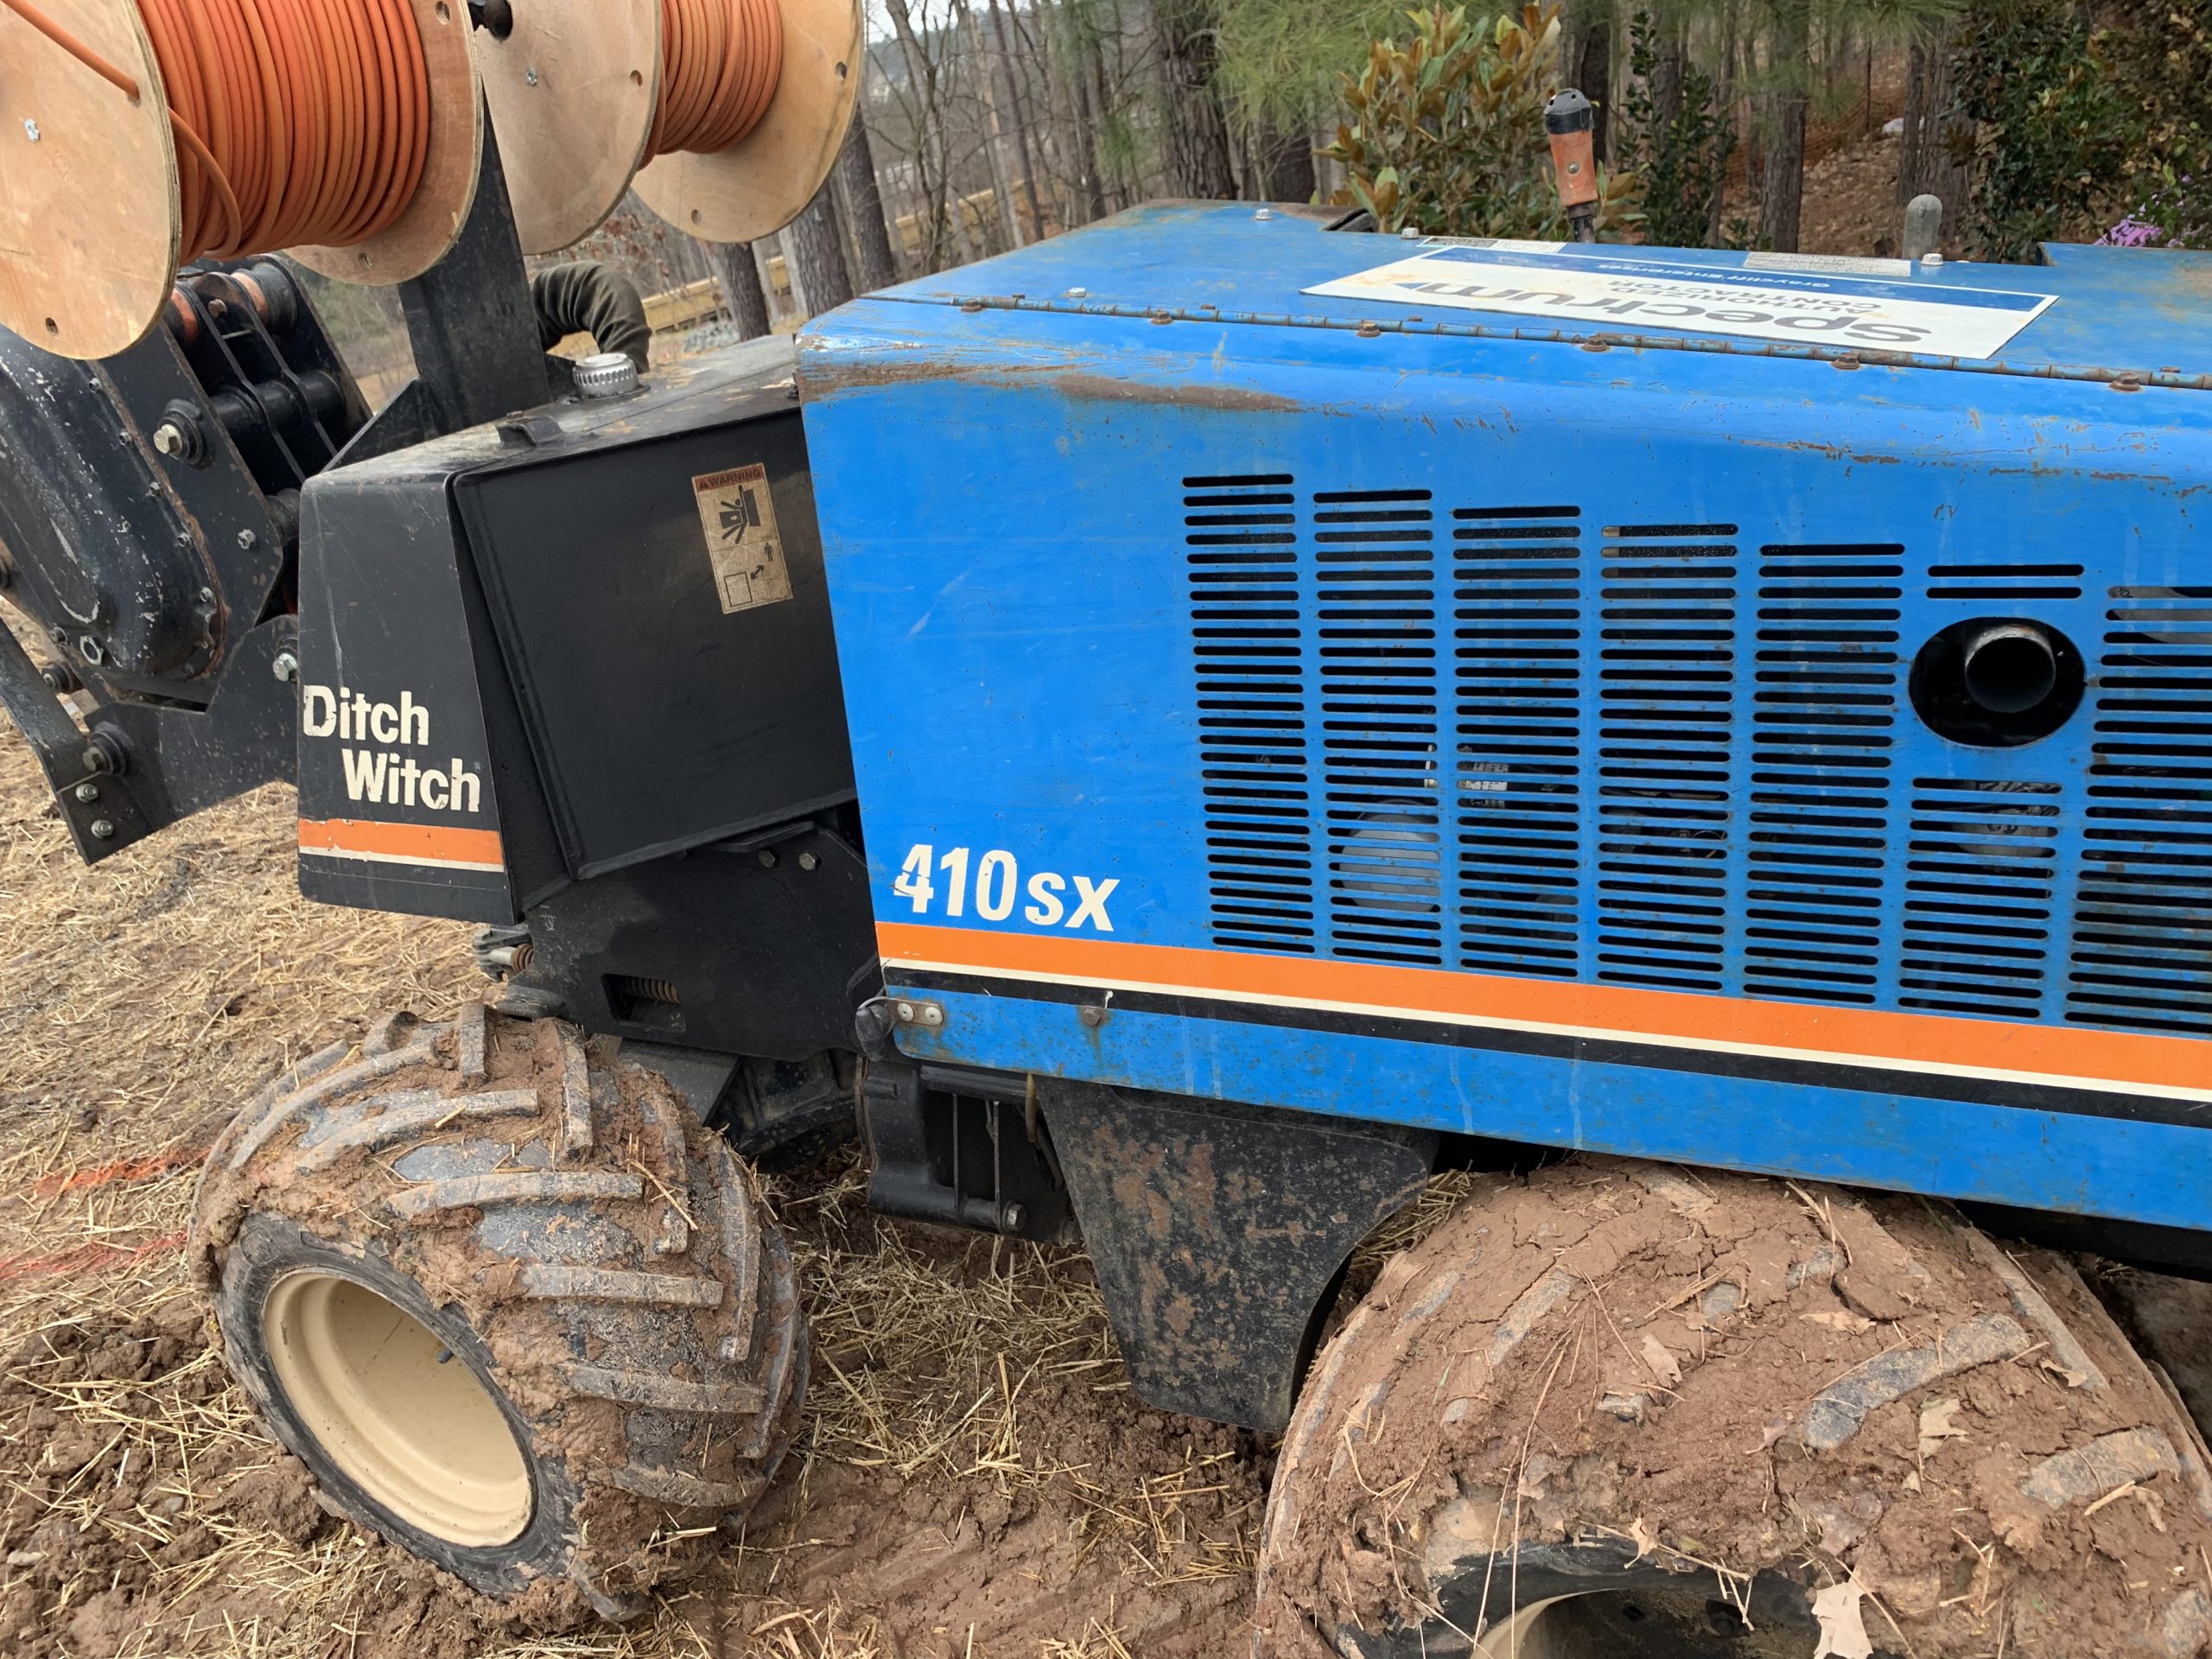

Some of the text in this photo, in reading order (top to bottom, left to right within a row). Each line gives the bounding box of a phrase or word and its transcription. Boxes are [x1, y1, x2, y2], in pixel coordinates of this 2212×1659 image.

[1414, 283, 1932, 342] Spectrum
[1608, 280, 1882, 308] CONTRACTOR
[1610, 287, 1871, 314] AUTHORIZED
[709, 468, 761, 487] WARNING
[303, 684, 429, 746] Ditch
[341, 748, 481, 812] Witch
